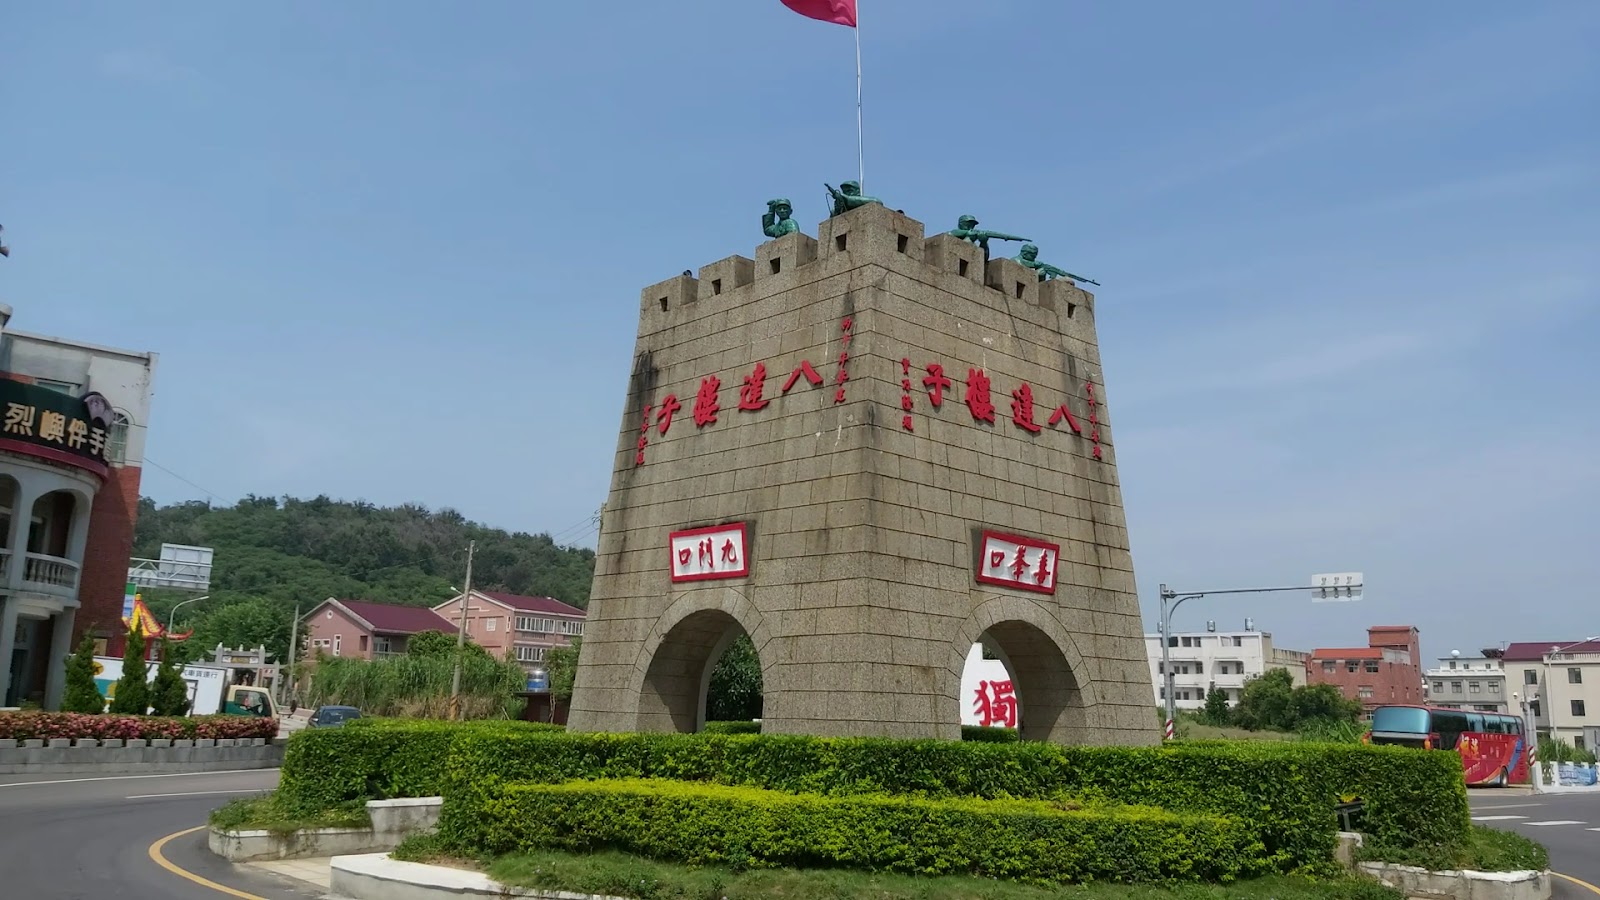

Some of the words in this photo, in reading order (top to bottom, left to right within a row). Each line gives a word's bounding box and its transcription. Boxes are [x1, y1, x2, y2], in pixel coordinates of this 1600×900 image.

[656, 360, 823, 433] 八達樓子
[922, 363, 1082, 434] 八達樓子
[4, 402, 111, 461] 烈嶼伴手
[678, 537, 737, 568] 九門口
